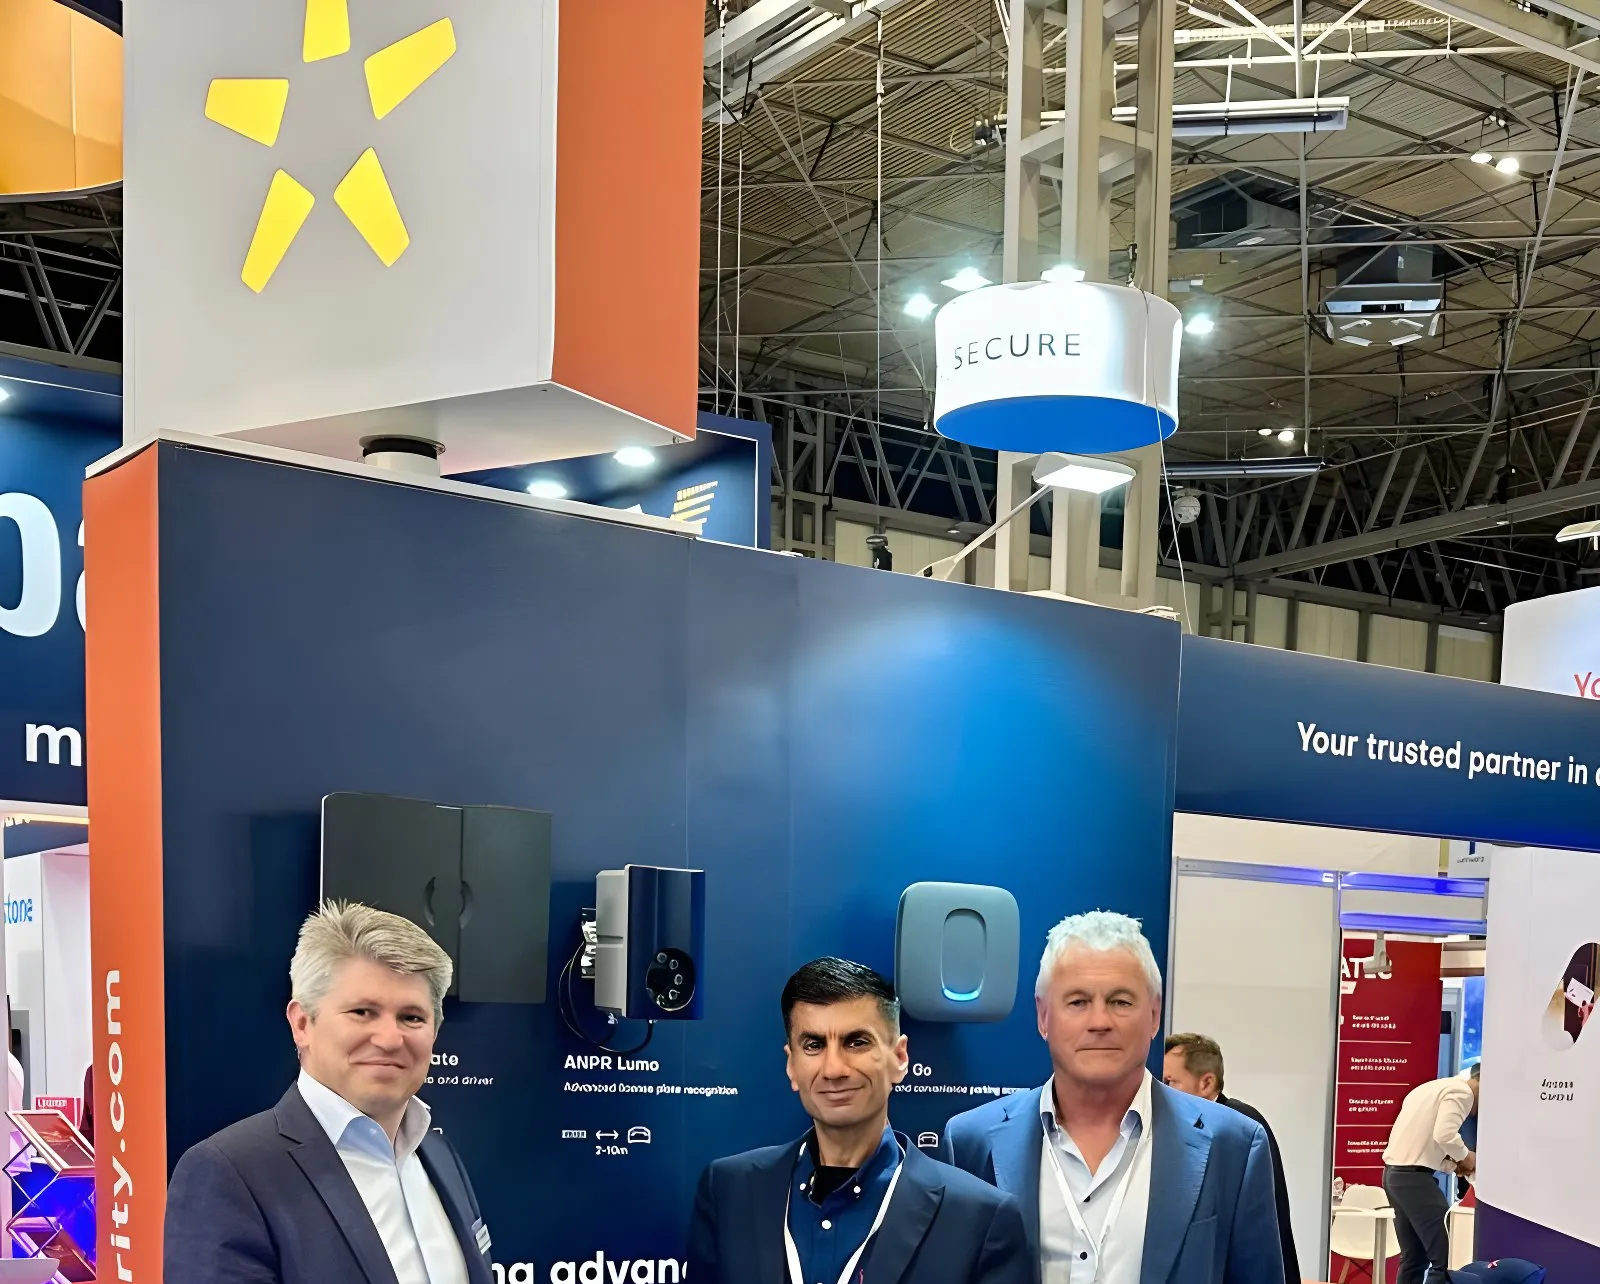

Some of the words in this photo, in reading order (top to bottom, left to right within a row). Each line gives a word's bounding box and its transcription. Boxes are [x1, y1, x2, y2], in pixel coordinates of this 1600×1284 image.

[954, 333, 1081, 370] SECURE
[1297, 721, 1358, 757] Your
[1366, 733, 1461, 769] trusted
[1468, 751, 1561, 780] partner
[1567, 755, 1588, 785] in
[4, 893, 33, 924] tone
[564, 1054, 612, 1070] ANPR
[617, 1056, 660, 1071] Lumo
[912, 1063, 932, 1076] Go
[564, 1082, 617, 1093] Advanced
[656, 1083, 681, 1095] plate
[683, 1085, 738, 1097] recognition
